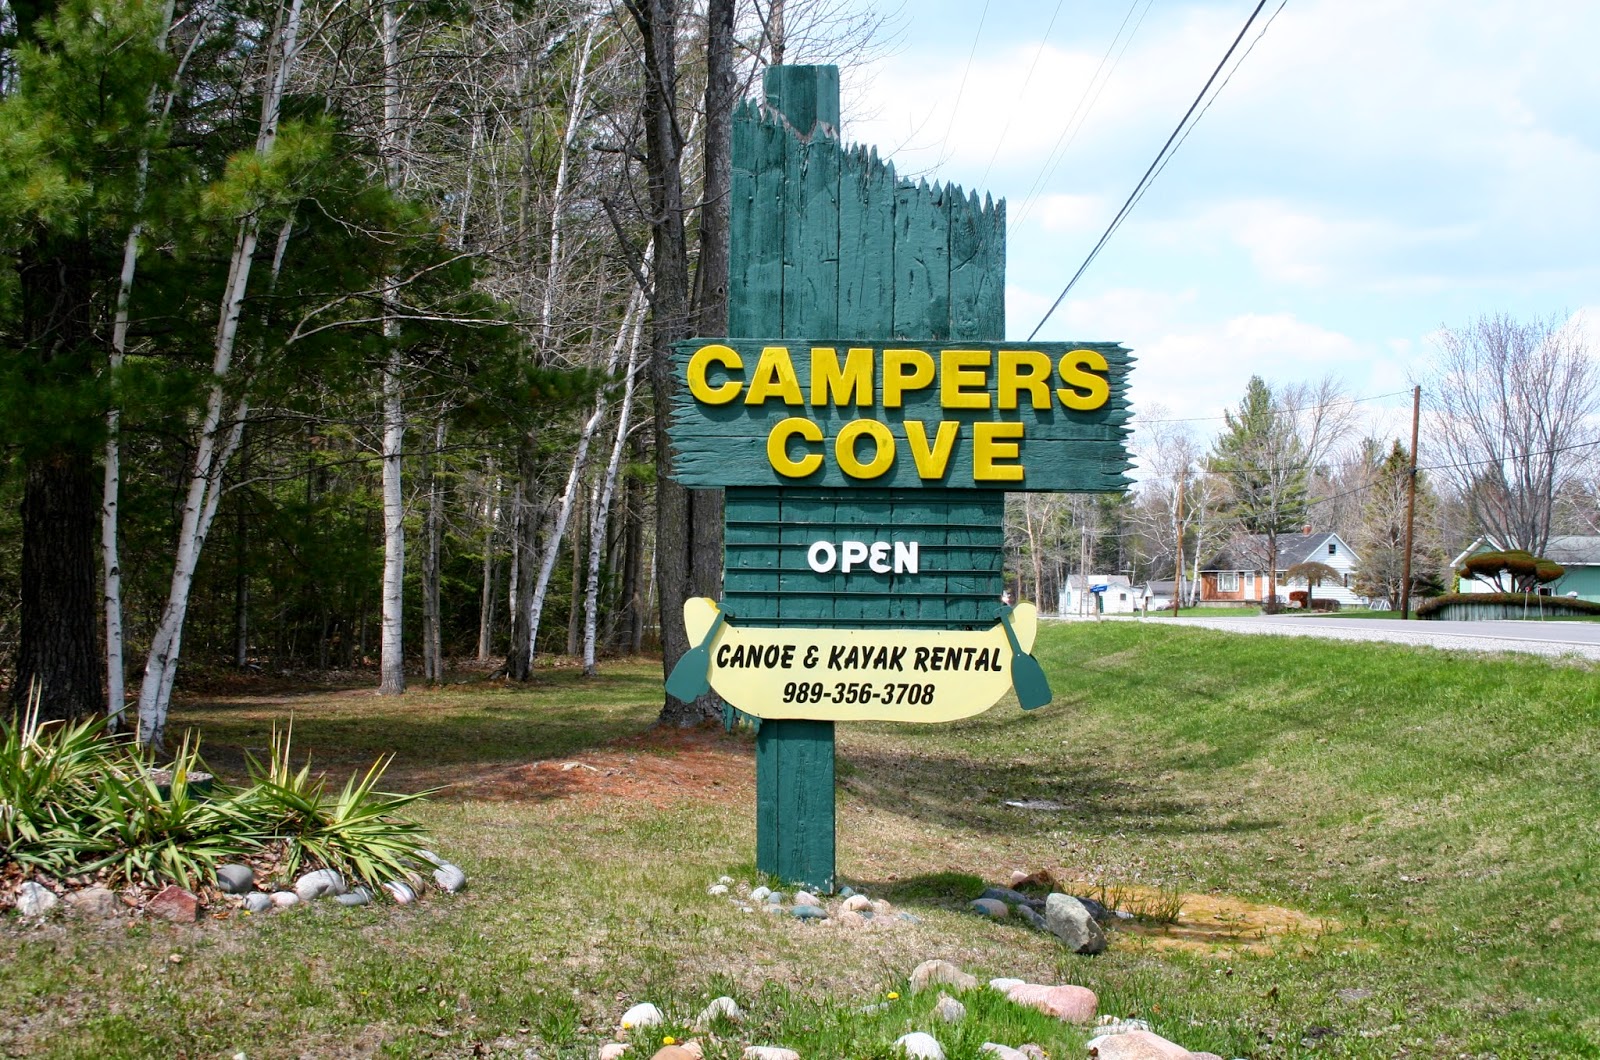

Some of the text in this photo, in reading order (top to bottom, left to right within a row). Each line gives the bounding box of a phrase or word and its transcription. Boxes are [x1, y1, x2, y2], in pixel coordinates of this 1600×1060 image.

[687, 344, 1109, 410] CAMPERS
[767, 417, 1024, 481] COVE
[807, 540, 919, 574] OPEN
[716, 644, 1002, 673] CANOE & KAYAK RENTAL
[782, 682, 935, 705] 989-356-3708
